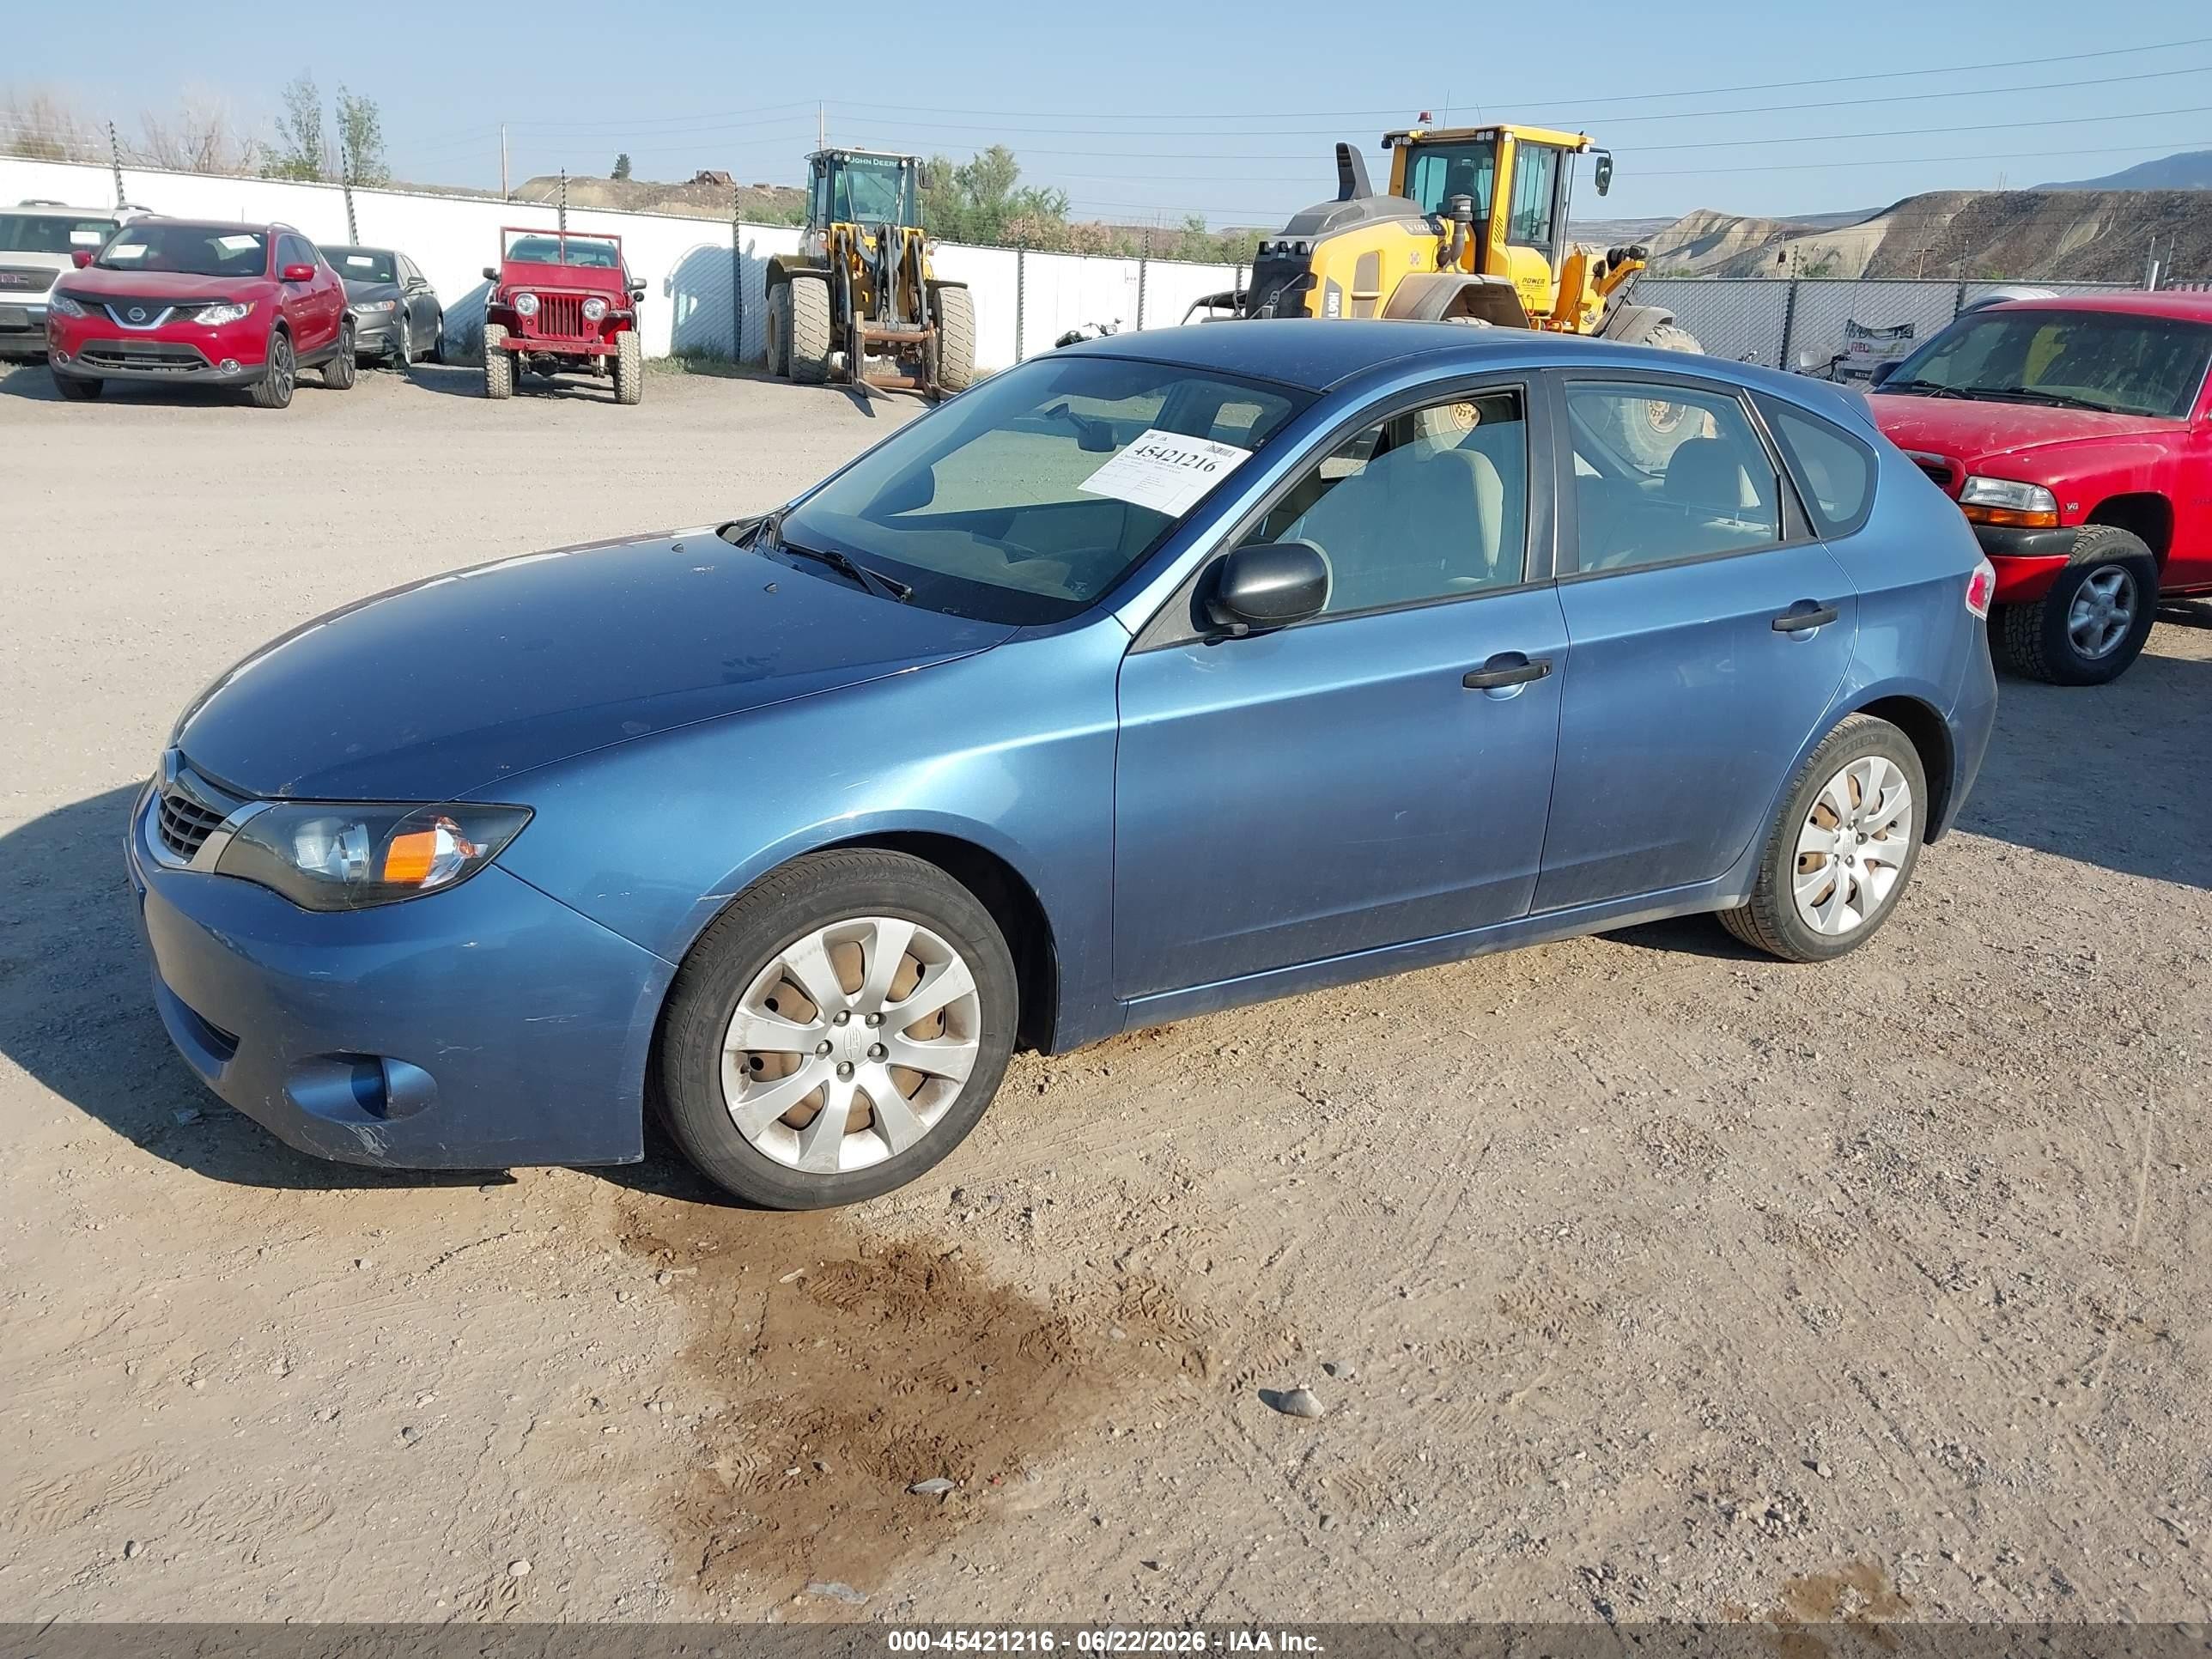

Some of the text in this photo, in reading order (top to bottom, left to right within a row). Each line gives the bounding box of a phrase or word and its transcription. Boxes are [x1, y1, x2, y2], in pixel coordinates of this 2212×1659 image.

[850, 156, 872, 165] JOHN
[1522, 276, 1546, 285] POWER
[1134, 445, 1224, 472] 45421216
